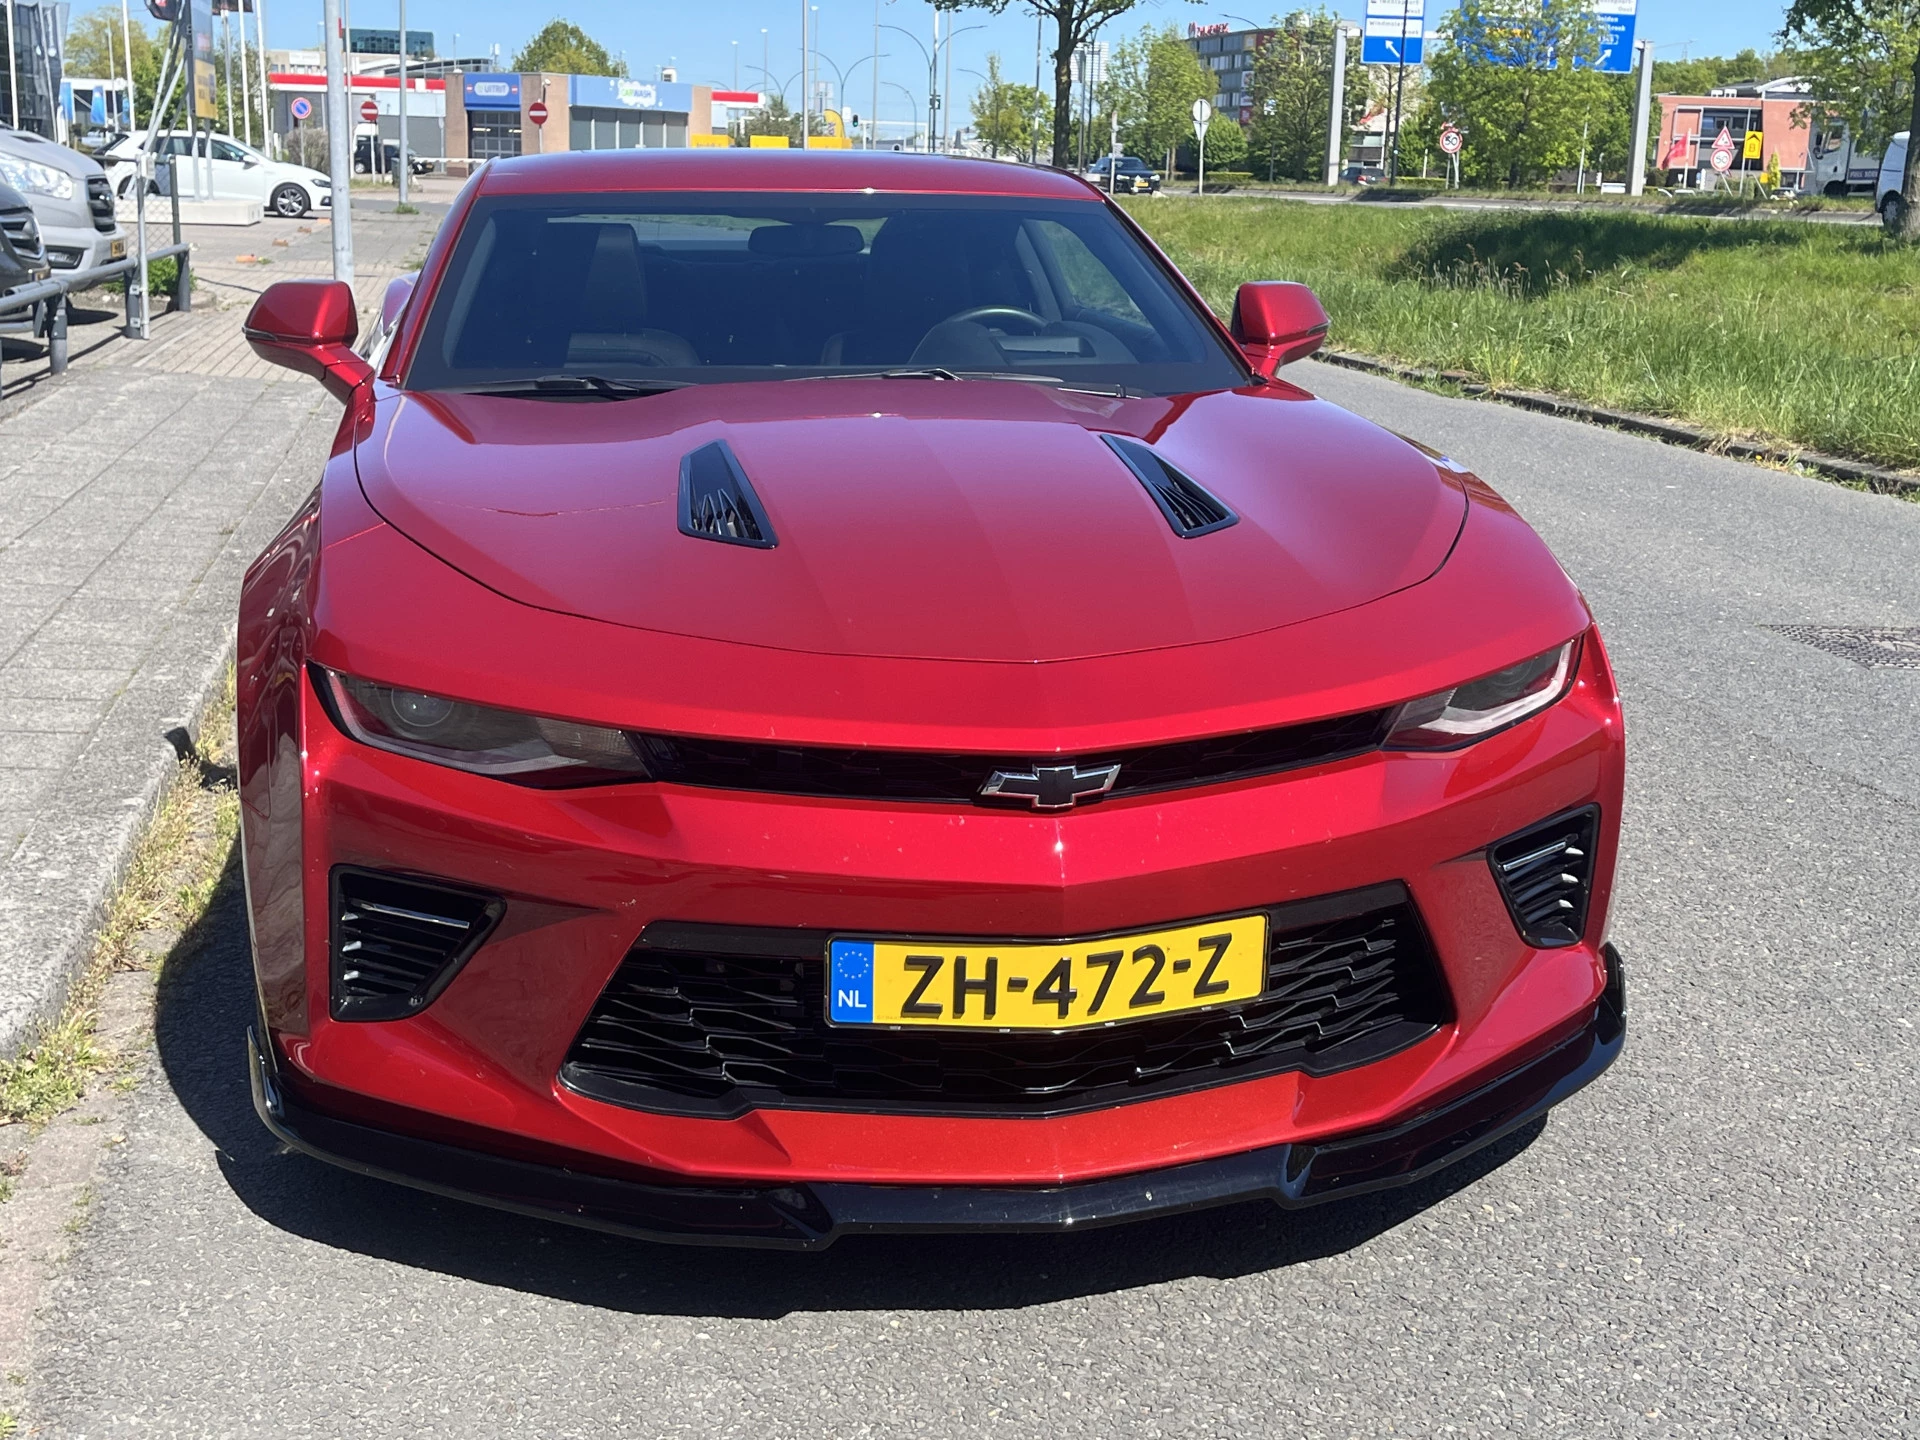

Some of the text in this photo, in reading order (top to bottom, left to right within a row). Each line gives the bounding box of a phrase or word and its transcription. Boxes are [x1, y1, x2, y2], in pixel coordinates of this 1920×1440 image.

[1444, 135, 1458, 146] 50
[1716, 155, 1728, 164] 50
[901, 933, 1233, 1019] ZH-472-Z
[838, 990, 867, 1008] NL
